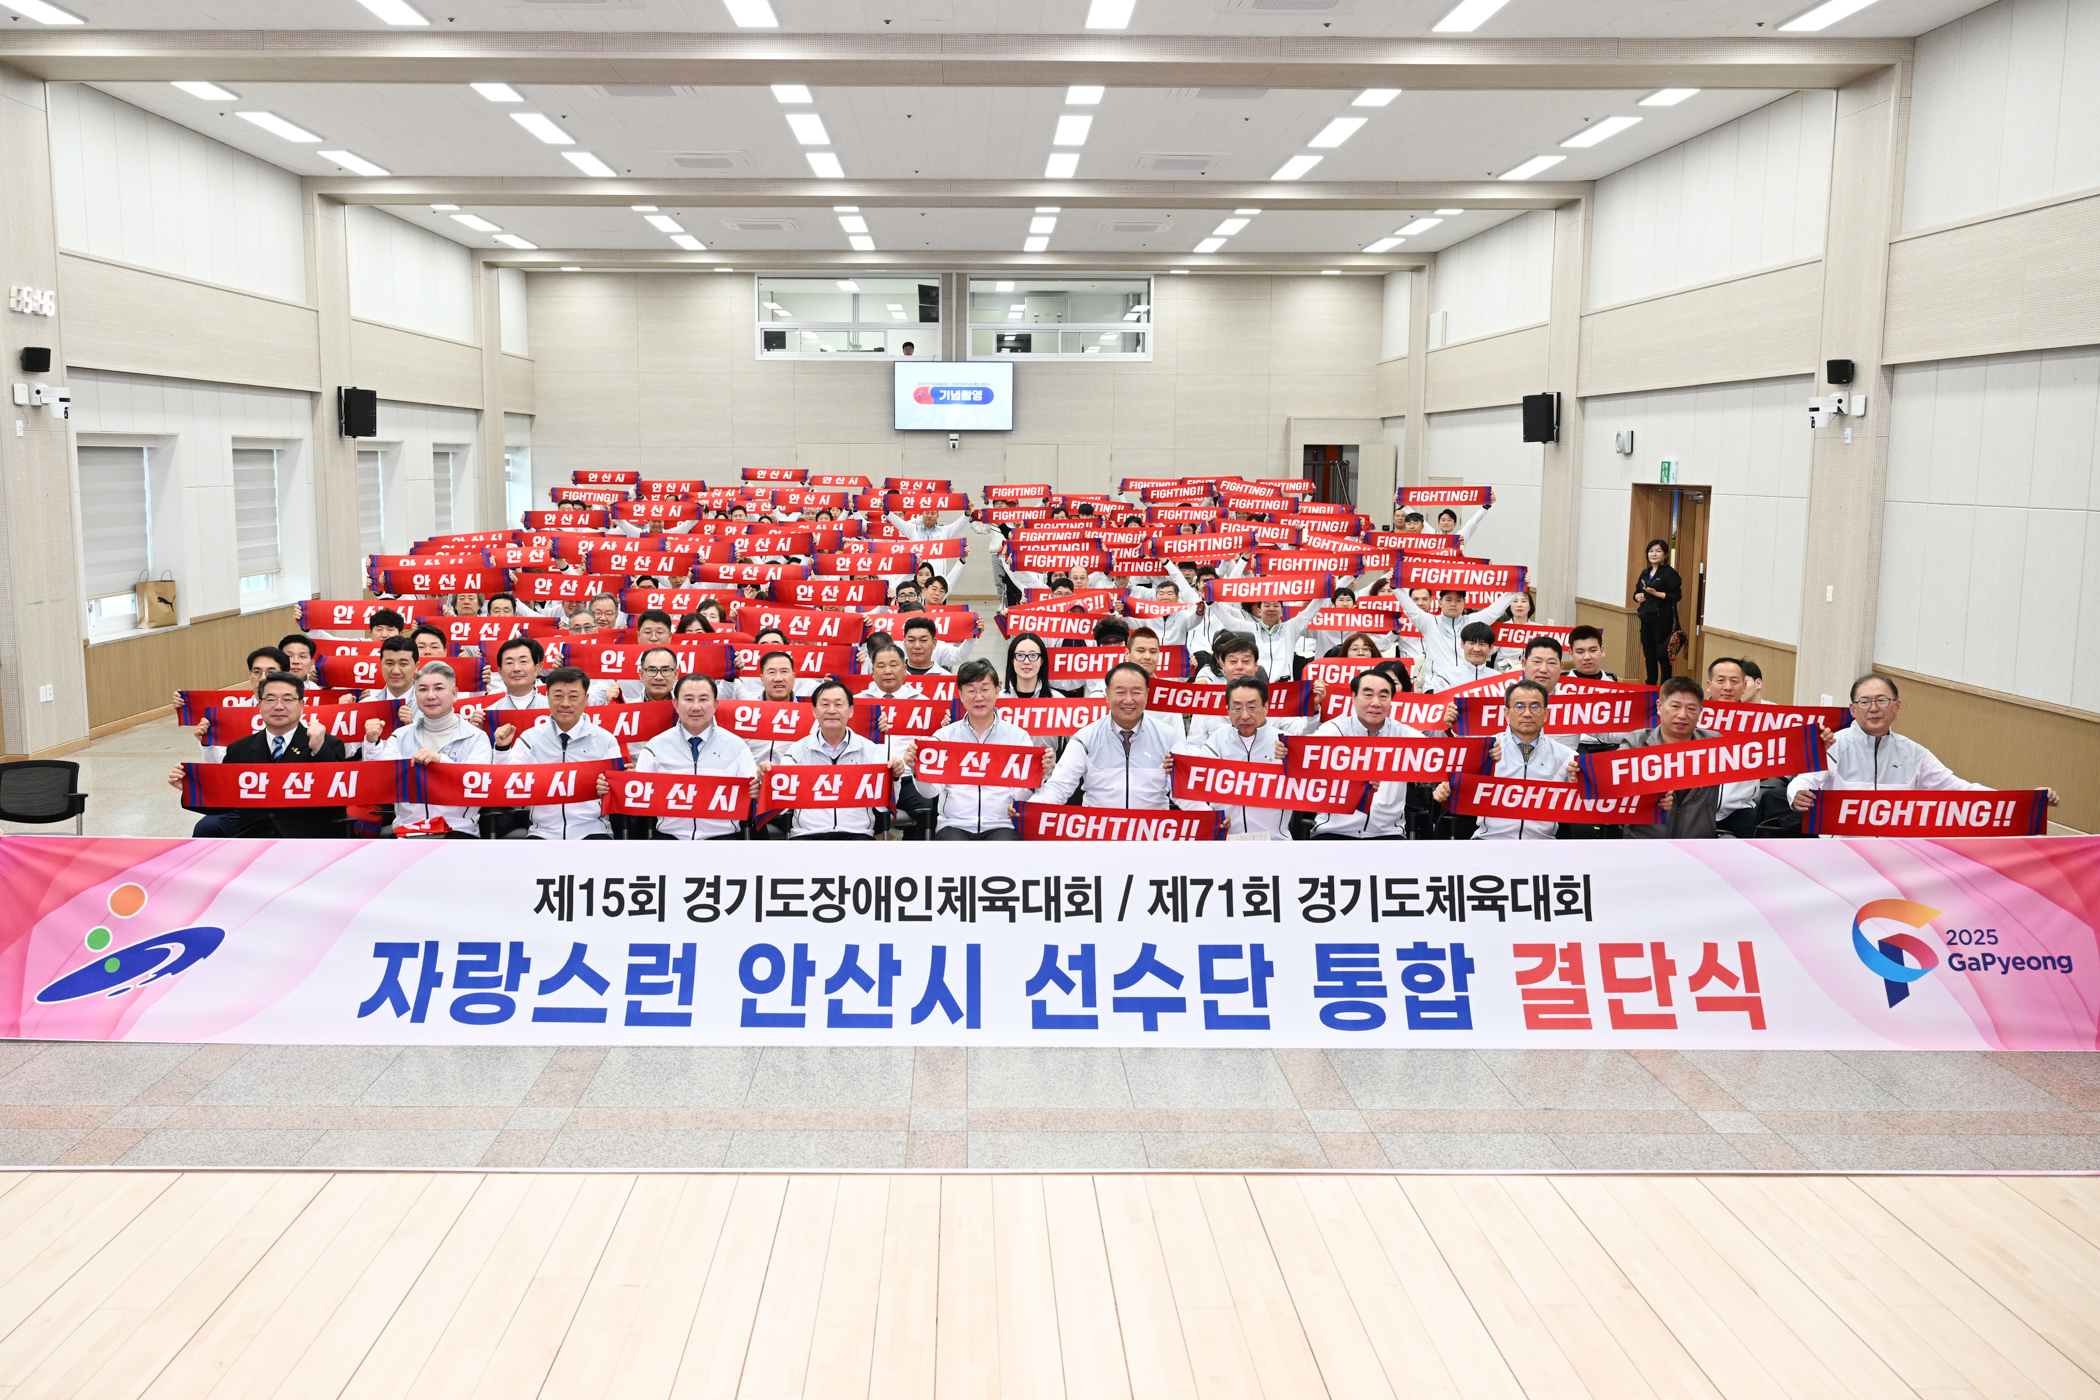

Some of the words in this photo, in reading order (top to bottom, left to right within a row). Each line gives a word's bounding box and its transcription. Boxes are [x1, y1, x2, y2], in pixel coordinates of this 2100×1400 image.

[588, 473, 625, 482] 안산시
[757, 470, 793, 479] 안산시
[823, 477, 858, 485] 안산시
[652, 483, 690, 493] 안산시
[900, 481, 935, 491] 안산시
[992, 487, 1044, 497] FIGHTING!!
[1150, 486, 1204, 498] FIGHTING!!
[1220, 480, 1274, 497] FIGHTING!!
[562, 491, 618, 502] FIGHTING!!
[789, 494, 830, 505] 안산시
[903, 497, 948, 508] 안산시
[1229, 498, 1288, 510] FIGHTING!!
[1409, 490, 1478, 501] FIGHTING!!
[633, 504, 682, 517] 안산시
[992, 511, 1046, 520] FIGHTING!!
[1158, 510, 1217, 520] FIGHTING!!
[544, 514, 589, 525] 안산시
[735, 537, 792, 552] 안산시
[1086, 531, 1141, 543] IGHTING!!
[1164, 536, 1243, 553] FIGHTING!!
[1377, 536, 1446, 549] FIGHTING!!
[506, 549, 544, 563] 안산
[611, 554, 674, 572] 안산시
[836, 557, 893, 571] 안산시
[1024, 555, 1099, 568] FIGHTING!!
[1269, 558, 1348, 571] FIGHTING!!
[719, 565, 782, 580] 안산시
[1113, 562, 1162, 572] HTING!!
[413, 573, 481, 590] 안산시
[1410, 568, 1508, 586] FIGHTING!!
[534, 578, 603, 596] 안산시
[796, 585, 864, 602] 안산시
[1222, 579, 1315, 597] FIGHTING!!
[760, 613, 841, 637] 안산시
[875, 617, 950, 635] 안시
[1009, 615, 1096, 634] FIGHTING!
[1312, 613, 1384, 627] GHTING!!
[600, 650, 695, 674] 안시
[740, 650, 824, 673] 안시
[734, 706, 818, 734] 안산
[998, 706, 1109, 729] GHTING!!
[1481, 701, 1632, 727] FITING!!
[1696, 708, 1825, 732] GHTING!!
[919, 748, 1033, 780] 안산시
[1302, 745, 1467, 772] FIGHTING!!
[1611, 737, 1787, 785] FIGHTING!!
[239, 771, 358, 799] 안산시
[463, 770, 577, 799] 안산시
[771, 772, 885, 801] 안산시
[1187, 766, 1350, 804] FIGHTING!!
[624, 781, 739, 812] 안산시
[1472, 783, 1640, 814] FIGHTING!!
[1838, 798, 2016, 827] FIGHTING!!
[1038, 812, 1200, 841] FIGHTING!!
[534, 875, 664, 922] 제15회
[684, 876, 1100, 922] 경기도장애인체육대회
[1148, 876, 1279, 922] 제71회
[1298, 875, 1591, 922] 경기도체육대회
[1946, 929, 1998, 945] 2025
[1948, 952, 2073, 975] GaPyeong
[357, 941, 697, 1027] 자랑스런
[739, 943, 981, 1029] 안산시
[1026, 943, 1274, 1031] 선수단
[1314, 942, 1475, 1031] 통합
[1513, 942, 1766, 1030] 결단식
